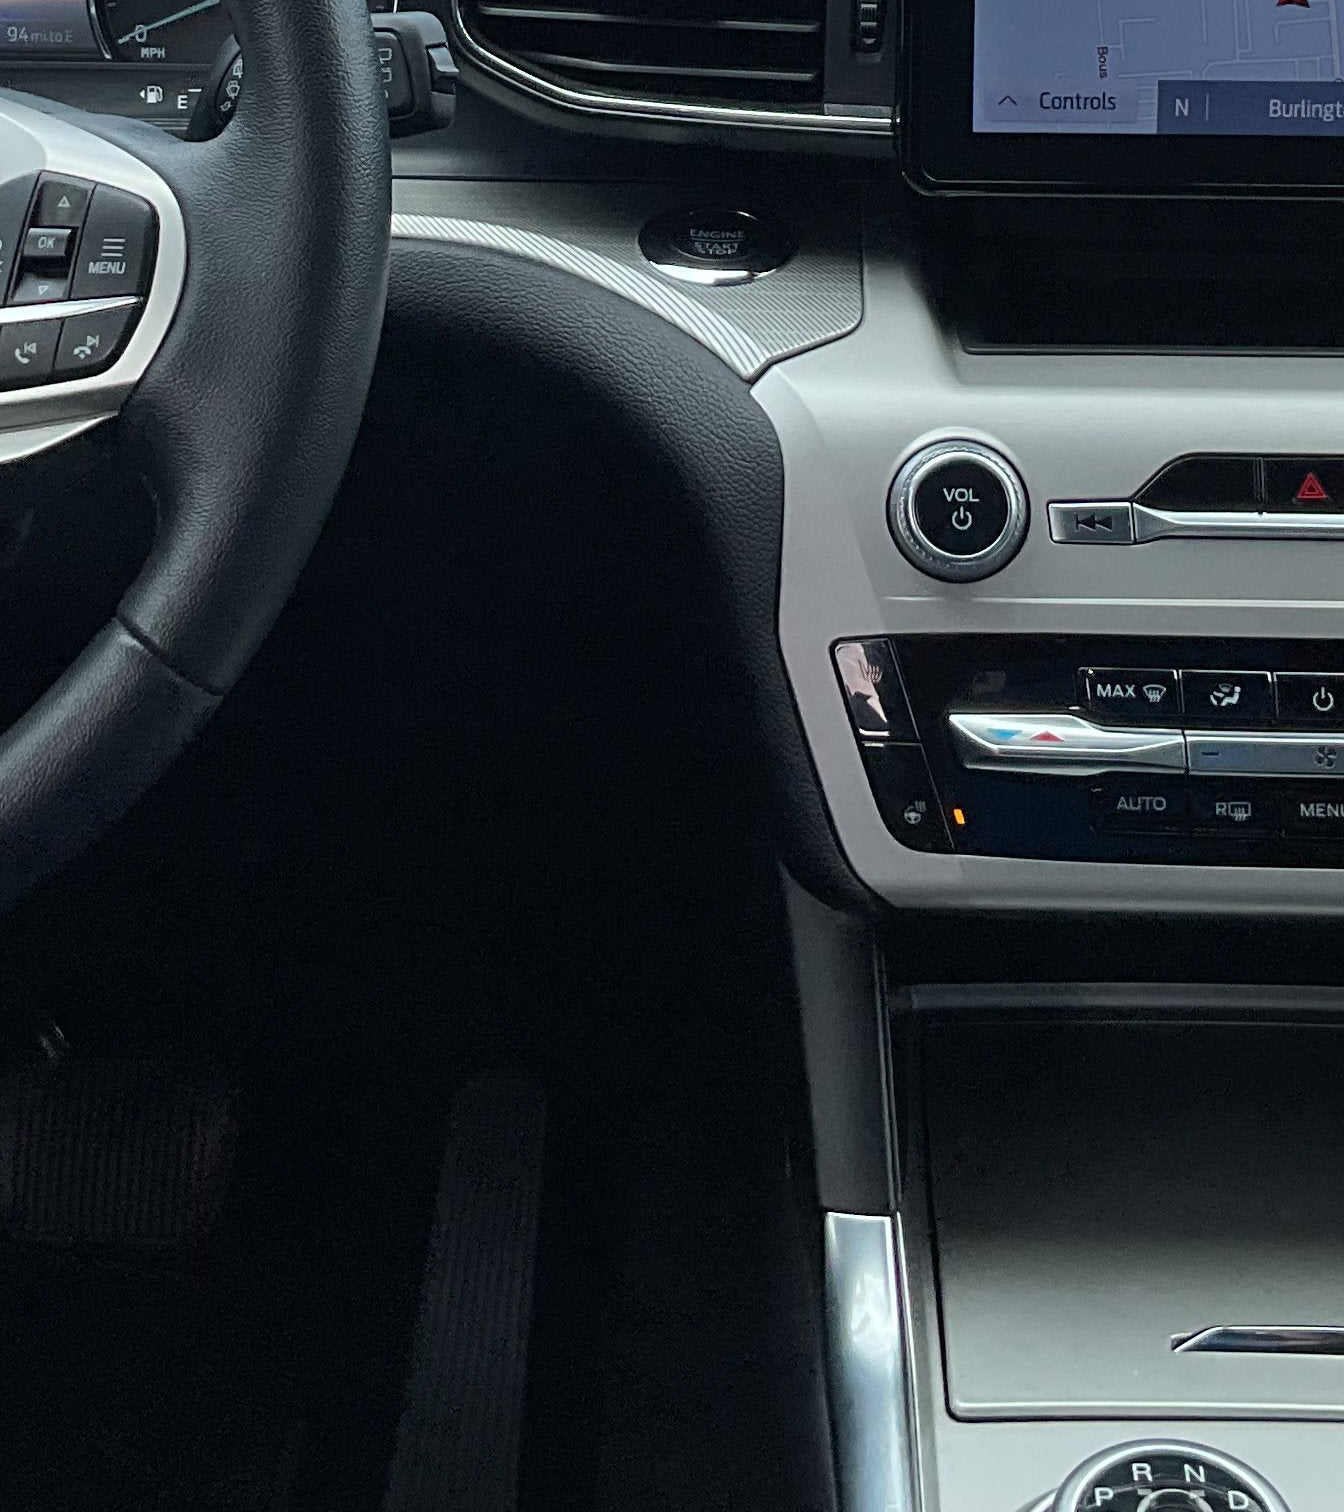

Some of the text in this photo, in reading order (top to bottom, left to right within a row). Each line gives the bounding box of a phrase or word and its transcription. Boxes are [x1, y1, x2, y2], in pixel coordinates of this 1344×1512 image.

[7, 26, 29, 42] 94
[140, 48, 166, 58] MPH
[177, 95, 188, 109] E
[1039, 91, 1117, 111] Controls
[1174, 98, 1190, 117] N
[689, 228, 745, 239] ENGINE
[37, 237, 55, 249] OK
[693, 242, 739, 250] START
[88, 261, 126, 275] MENU
[943, 487, 979, 503] VOL
[1096, 683, 1136, 699] MAX
[1117, 795, 1167, 813] AUTO
[1132, 1463, 1154, 1482] R
[1183, 1463, 1206, 1484] N
[1094, 1487, 1114, 1507] P
[1228, 1490, 1250, 1510] D
